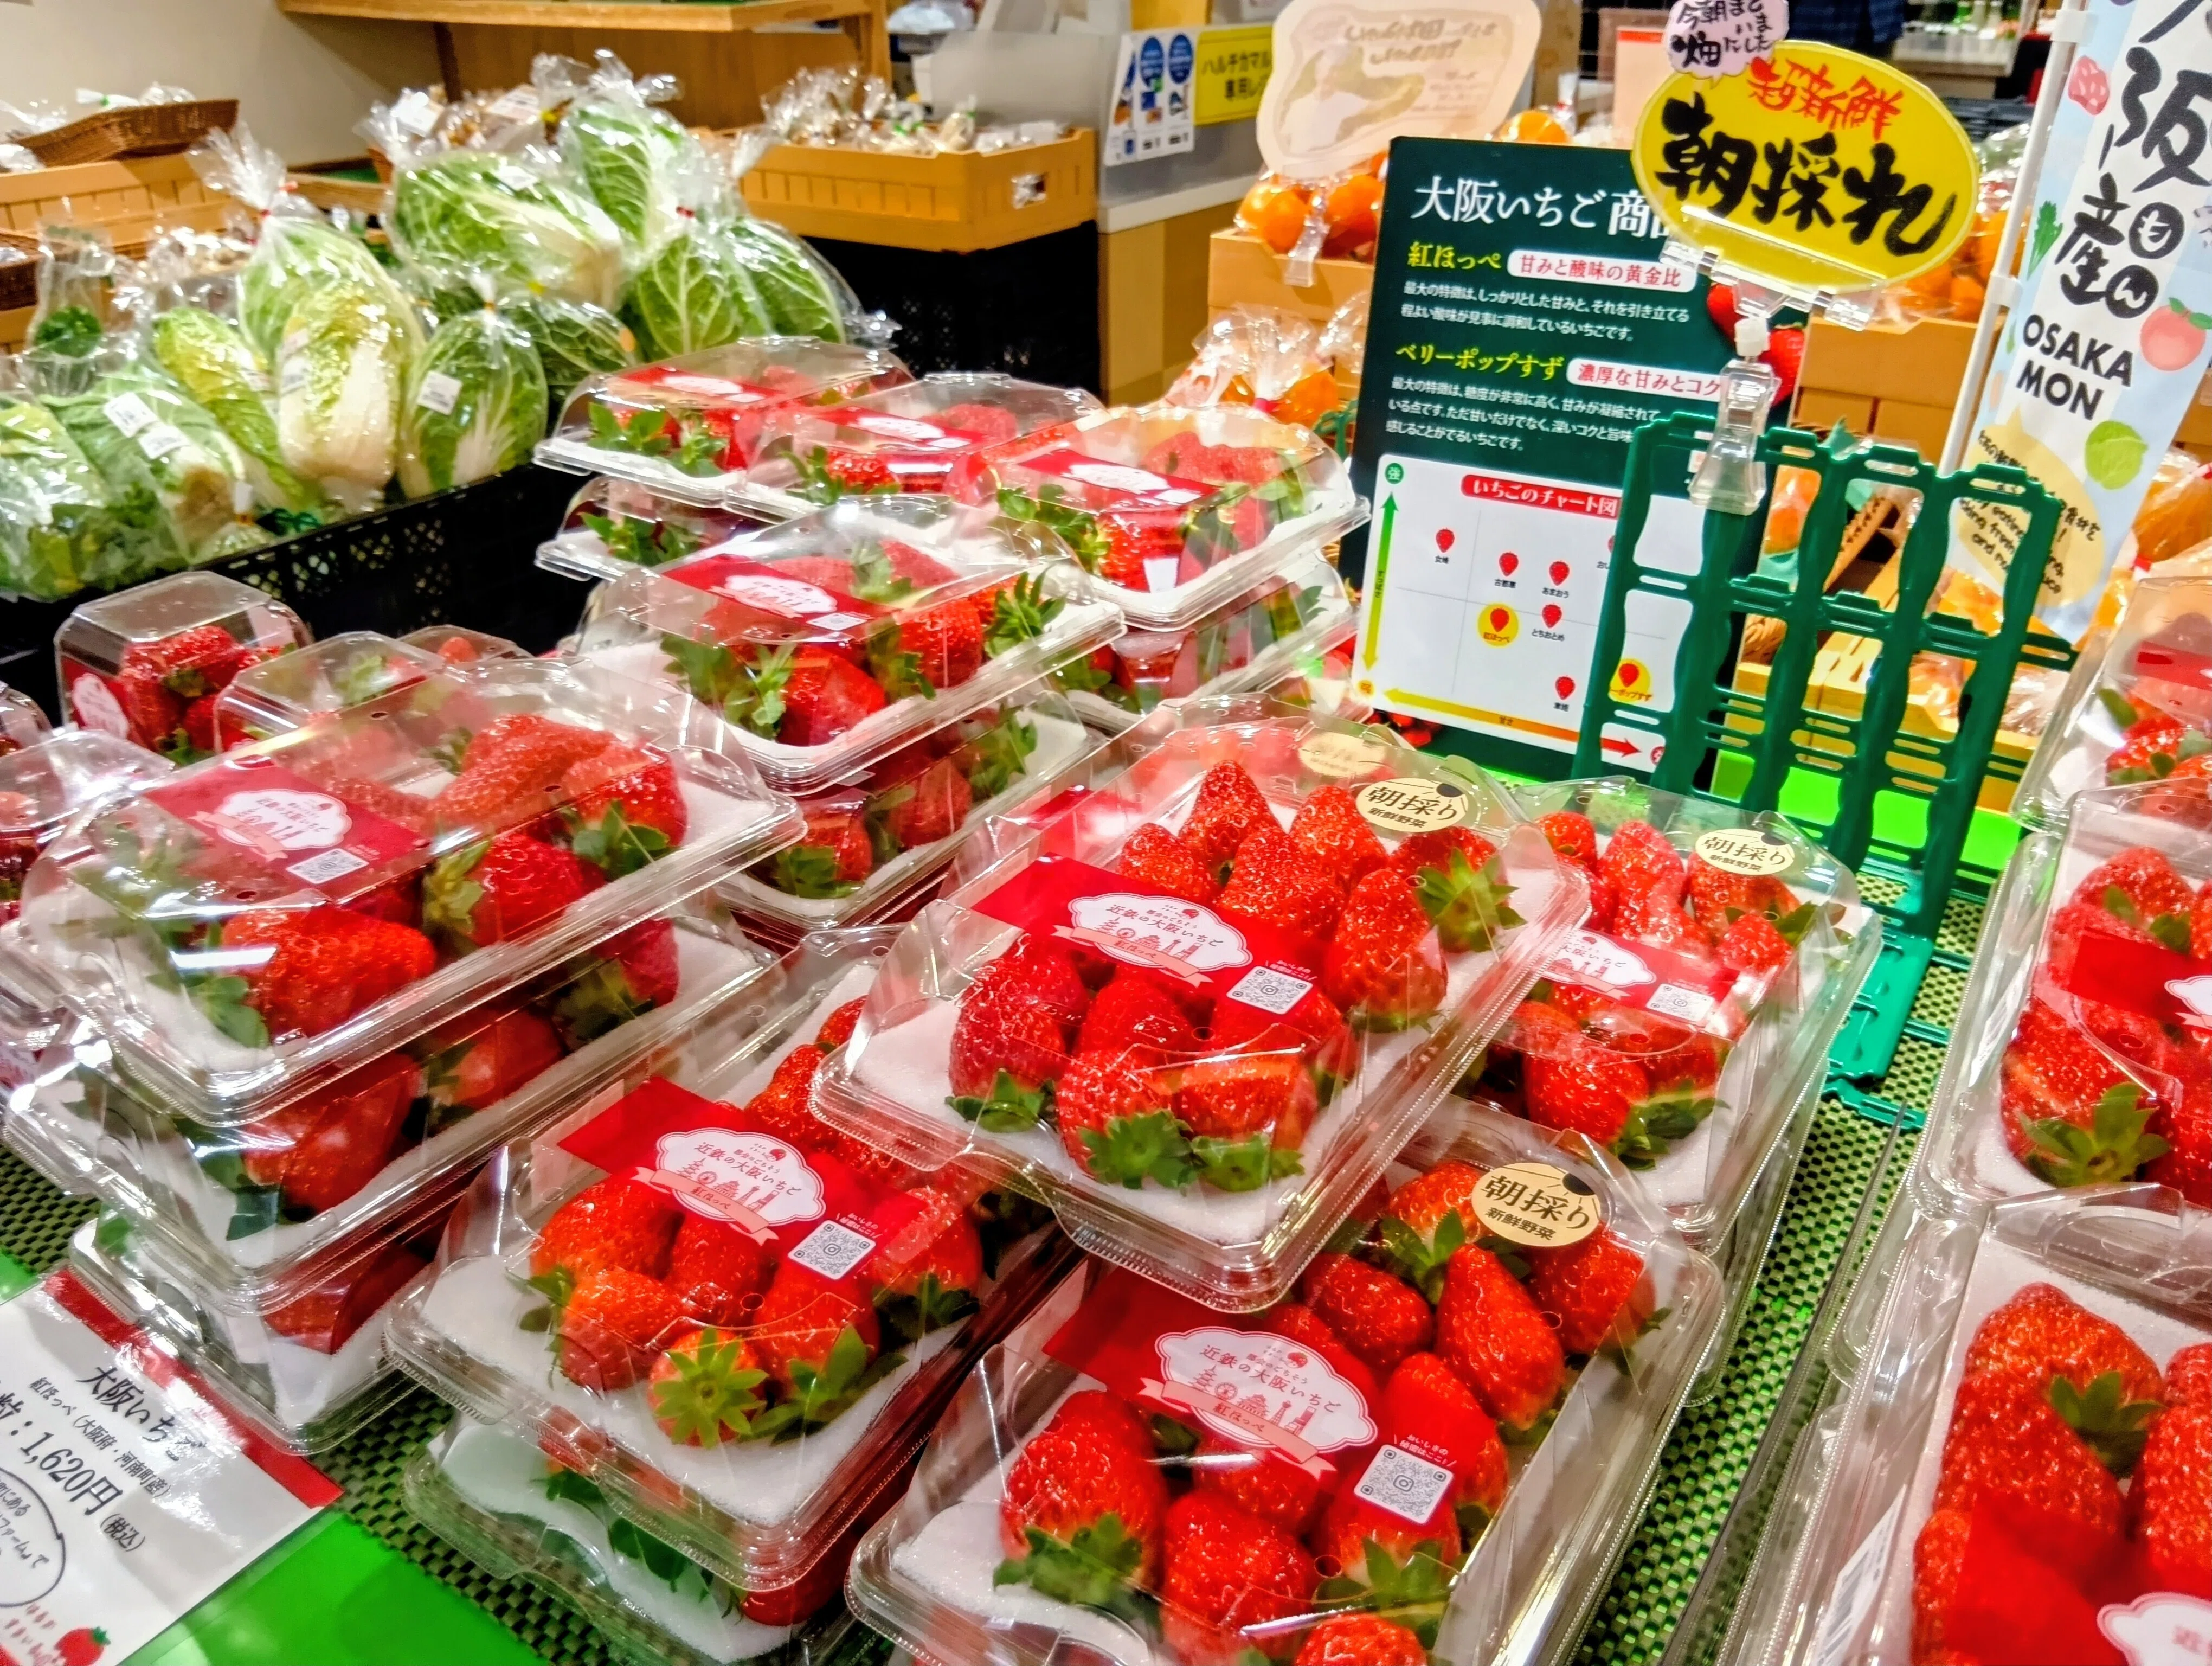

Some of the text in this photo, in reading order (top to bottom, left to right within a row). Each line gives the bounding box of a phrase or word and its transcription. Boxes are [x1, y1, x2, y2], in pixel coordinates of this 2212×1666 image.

[1747, 56, 1904, 142] 超新鮮
[1655, 91, 1958, 257] 朝採れ
[1407, 241, 1501, 270] 紅ほっぺ
[1519, 254, 1681, 287] 甘みと酸味の黄金比
[1395, 344, 1564, 381] ベリーポップすず
[2022, 313, 2133, 387] OSAKA
[2016, 359, 2104, 421] MON
[1472, 478, 1618, 516] いちごのチャート図
[1365, 786, 1458, 821] 朝採り
[1367, 807, 1428, 829] 新鮮野菜
[1702, 836, 1785, 866] 朝採り
[1481, 1175, 1590, 1229] 朝採り
[1485, 1207, 1557, 1241] 新鮮野菜
[1199, 1344, 1341, 1413] 近鉄の大阪いちご
[1213, 1402, 1265, 1432] 紅ほっぺ
